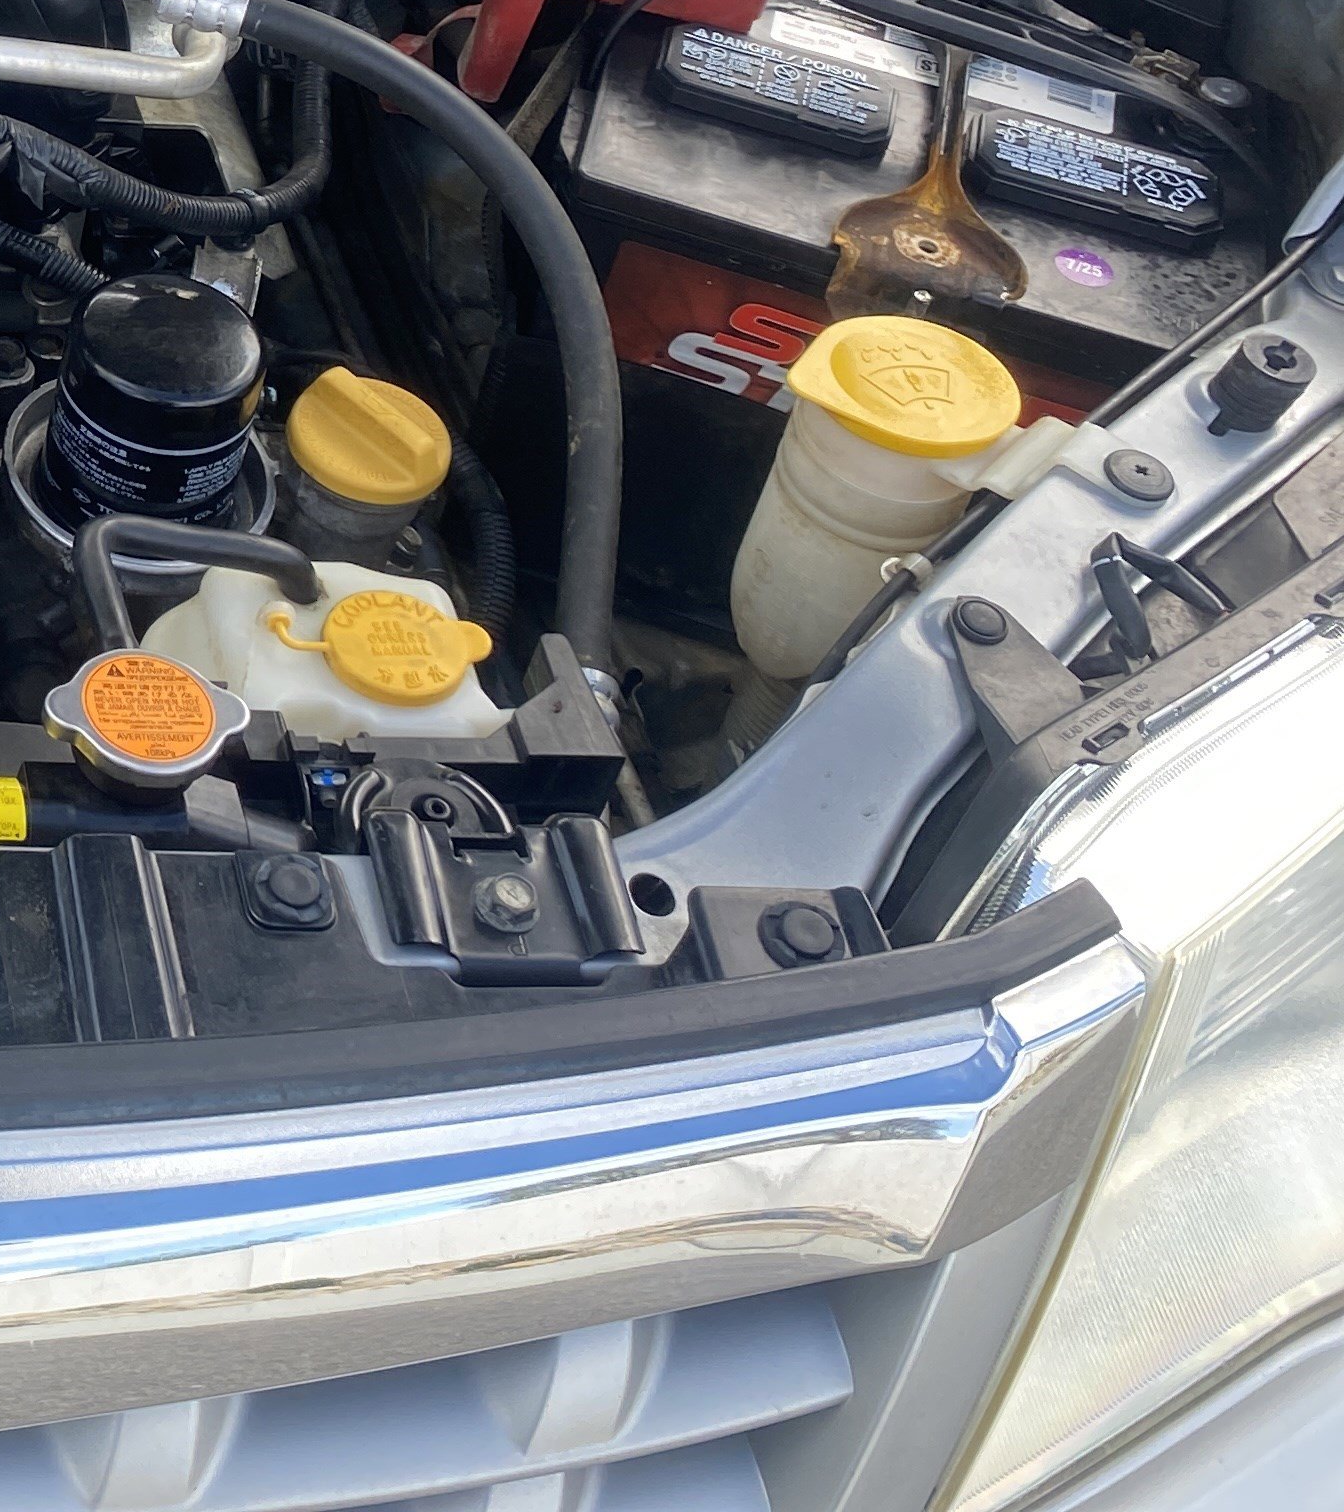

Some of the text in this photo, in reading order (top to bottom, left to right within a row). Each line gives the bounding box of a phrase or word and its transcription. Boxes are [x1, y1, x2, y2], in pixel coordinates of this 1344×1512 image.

[711, 32, 783, 60] DANGER
[802, 57, 867, 83] POISON
[1065, 258, 1103, 278] 7/25
[332, 593, 445, 628] COOLANT
[371, 643, 432, 657] MANUAL
[125, 667, 176, 676] WARNING
[93, 696, 200, 706] NEVER OPEN WHEN HOT
[175, 704, 201, 713] CHAUD
[116, 731, 195, 743] AVERTISSEMENT
